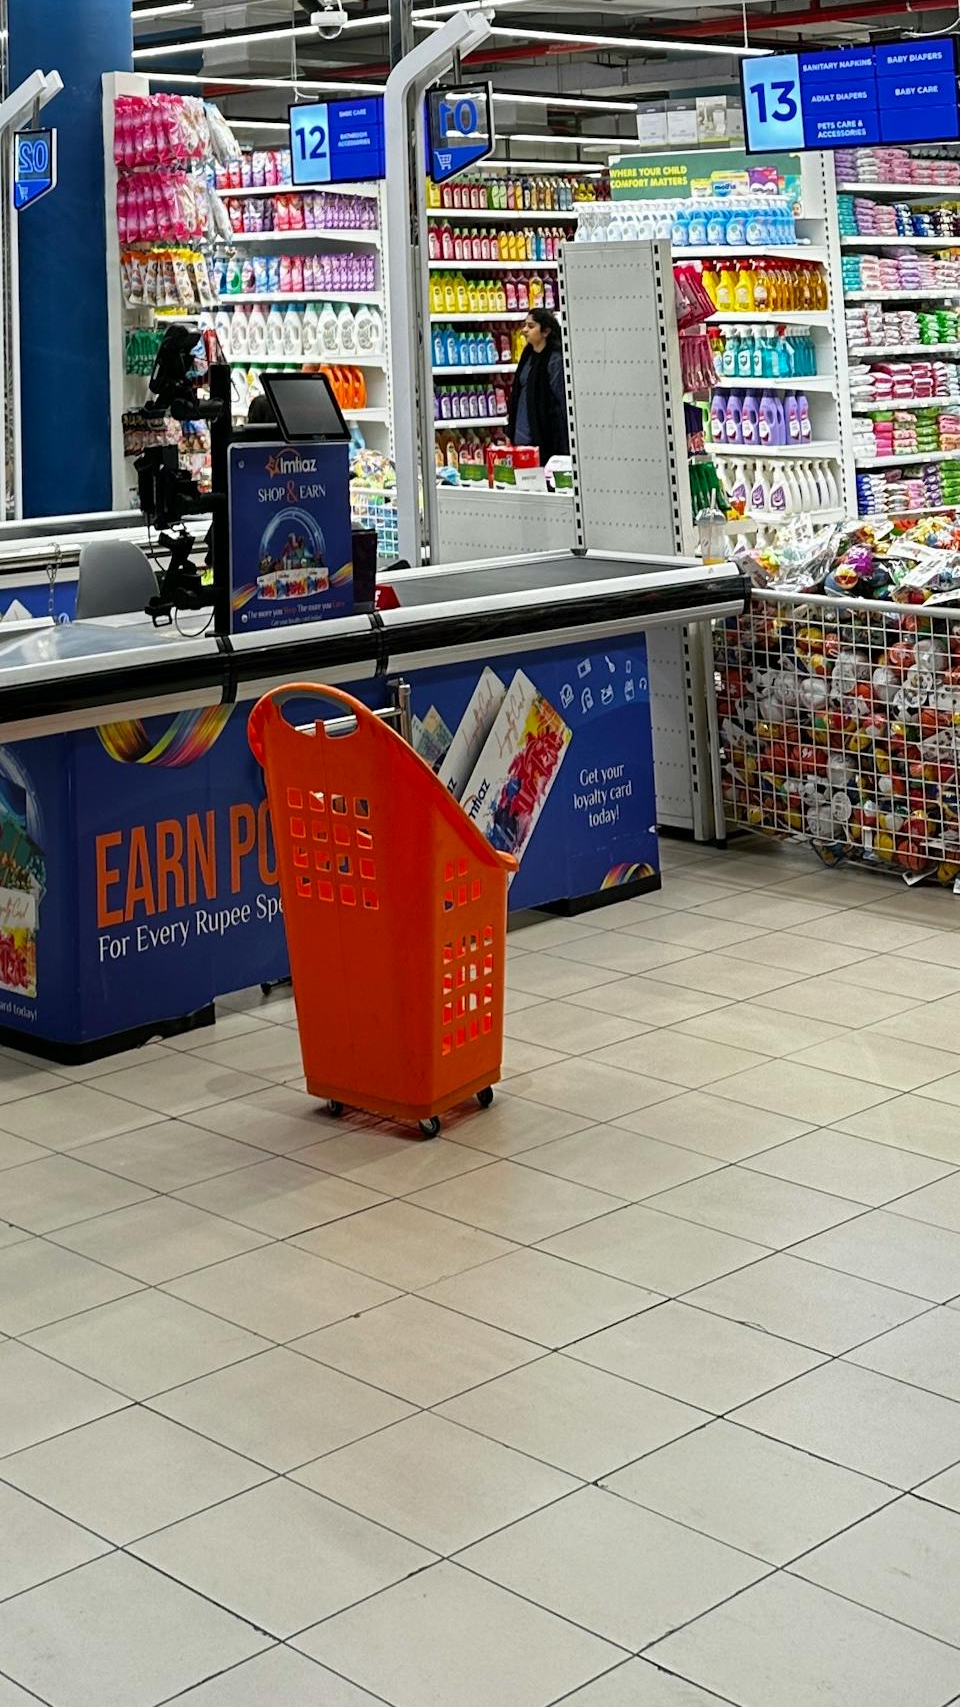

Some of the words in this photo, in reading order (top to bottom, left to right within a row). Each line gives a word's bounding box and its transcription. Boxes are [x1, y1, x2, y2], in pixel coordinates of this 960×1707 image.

[803, 62, 838, 72] SANITARY
[840, 59, 872, 68] NAPKINS
[887, 56, 908, 64] BABY
[910, 52, 942, 62] DIAPERS
[811, 94, 834, 102] ADULT
[836, 91, 867, 100] DIAPERS
[895, 88, 915, 96] BABY
[917, 86, 938, 94] CARE
[750, 81, 797, 122] 13
[818, 122, 835, 130] PETS
[837, 120, 856, 128] CARE
[818, 128, 866, 138] ACCESSORIES
[295, 126, 326, 160] 12
[610, 168, 636, 178] WHERE
[638, 167, 662, 176] YOUR
[662, 166, 687, 175] CHILD
[610, 179, 649, 189] COMFORT
[650, 176, 688, 186] MATTERS
[280, 457, 317, 474] Imtiaz
[258, 487, 286, 502] SHOP
[286, 481, 298, 504] &
[300, 484, 326, 500] EARN
[580, 769, 599, 786] Get
[601, 764, 625, 782] your
[574, 788, 608, 810] loyalty
[610, 780, 632, 800] card
[588, 806, 620, 828] today!
[96, 810, 217, 928] EARN
[98, 935, 130, 962] For
[136, 920, 190, 952] Every
[196, 904, 252, 936] Rupee
[13, 1002, 38, 1022] today!
